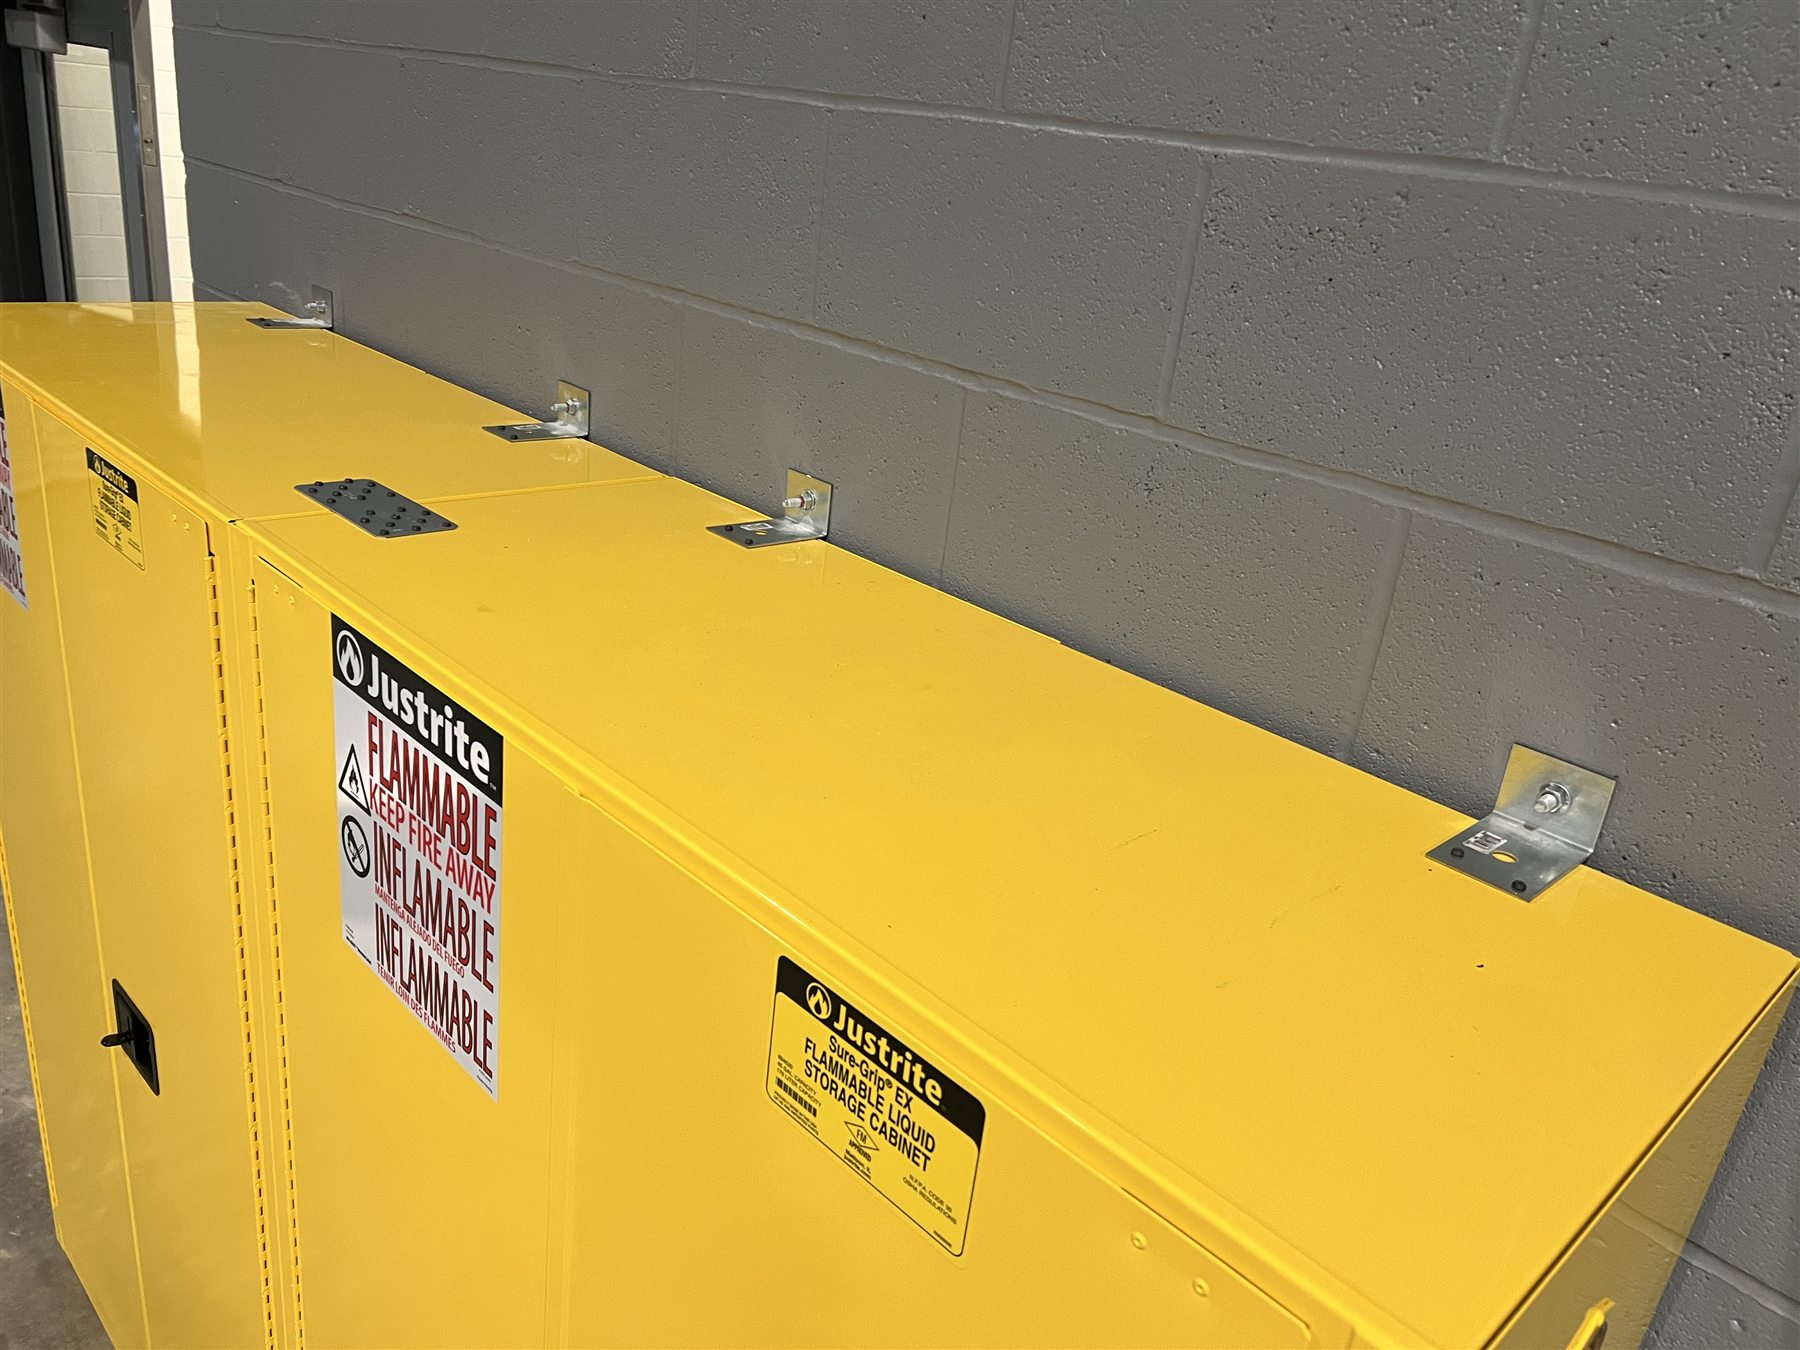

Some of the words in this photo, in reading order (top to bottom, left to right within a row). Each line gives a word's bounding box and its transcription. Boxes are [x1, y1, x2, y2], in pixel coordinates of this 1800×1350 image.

[368, 710, 497, 882] FLAMMABLE
[369, 778, 405, 833] KEEP
[408, 812, 442, 871] FIRE
[445, 846, 495, 914] AWAY
[373, 821, 494, 994] INFLAMABLE
[374, 883, 406, 924] MANTENGA
[406, 915, 432, 947] ALEJADO
[432, 941, 444, 960] DEL
[444, 951, 465, 979] FUEGO
[375, 902, 494, 1080] INFLAMMABLE
[377, 962, 395, 989] TENIR
[395, 981, 410, 1006] LOIN
[410, 998, 423, 1019] DES
[423, 1011, 456, 1054] FLAMMES
[805, 1036, 885, 1115] FLAMMABLE
[888, 1103, 936, 1154] LIQUID
[833, 1003, 943, 1107] Justrite
[895, 1086, 914, 1113] EX
[804, 1059, 866, 1122] STORAGE
[870, 1112, 931, 1173] CABINET
[856, 1129, 867, 1145] FM
